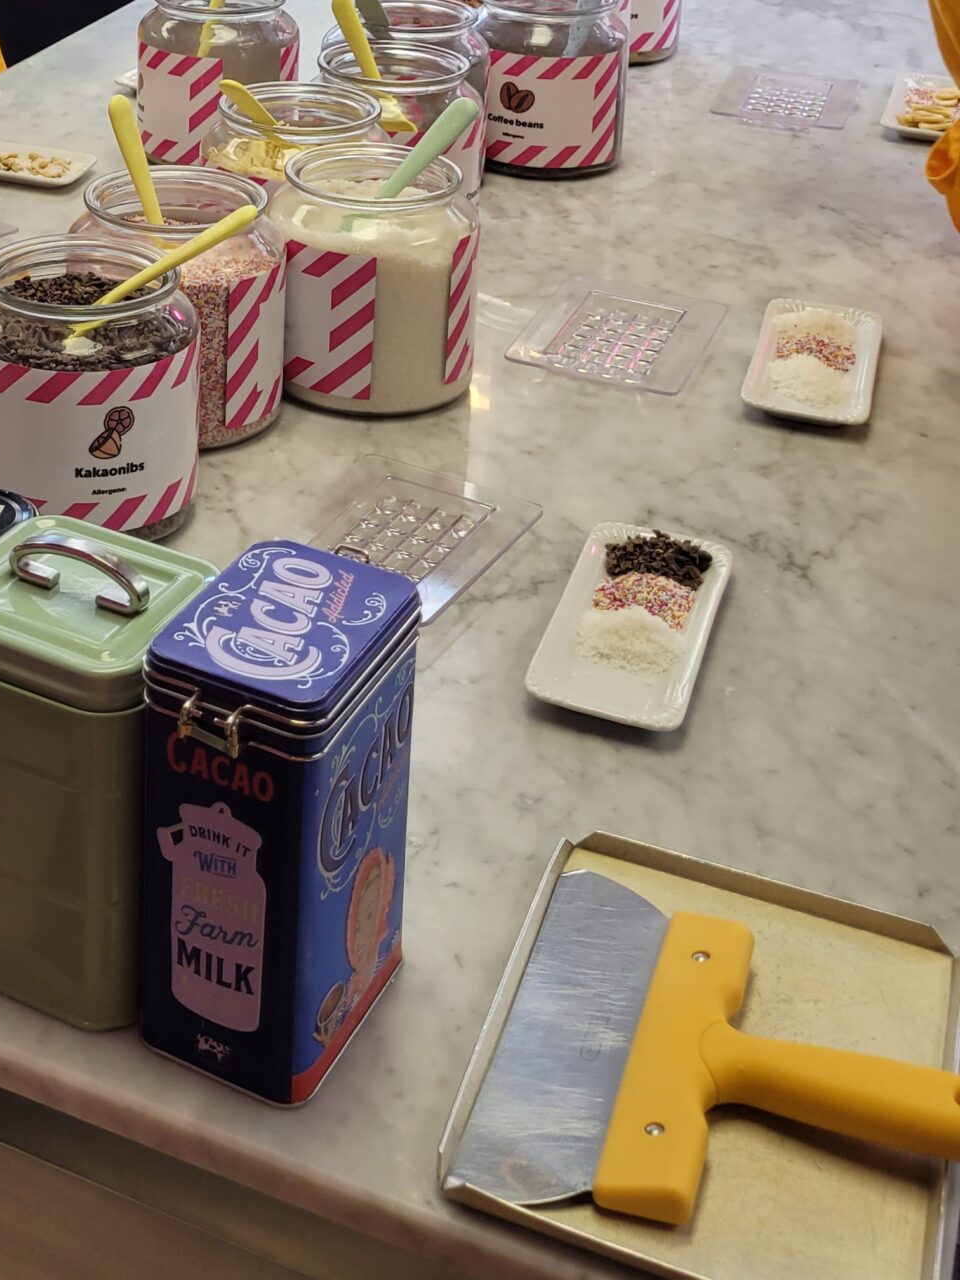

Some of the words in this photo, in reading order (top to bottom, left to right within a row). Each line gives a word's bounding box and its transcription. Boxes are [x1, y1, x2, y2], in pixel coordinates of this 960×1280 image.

[488, 113, 514, 125] Coffee
[515, 119, 544, 129] beans
[74, 461, 145, 479] Kakaonibs
[206, 557, 333, 680] CACAO
[322, 569, 354, 623] Addicted
[167, 731, 275, 802] CACAO
[317, 681, 413, 874] CACAO
[189, 825, 232, 847] DRINK
[236, 842, 251, 858] IT
[175, 904, 259, 948] Farm
[176, 936, 256, 996] MILK
